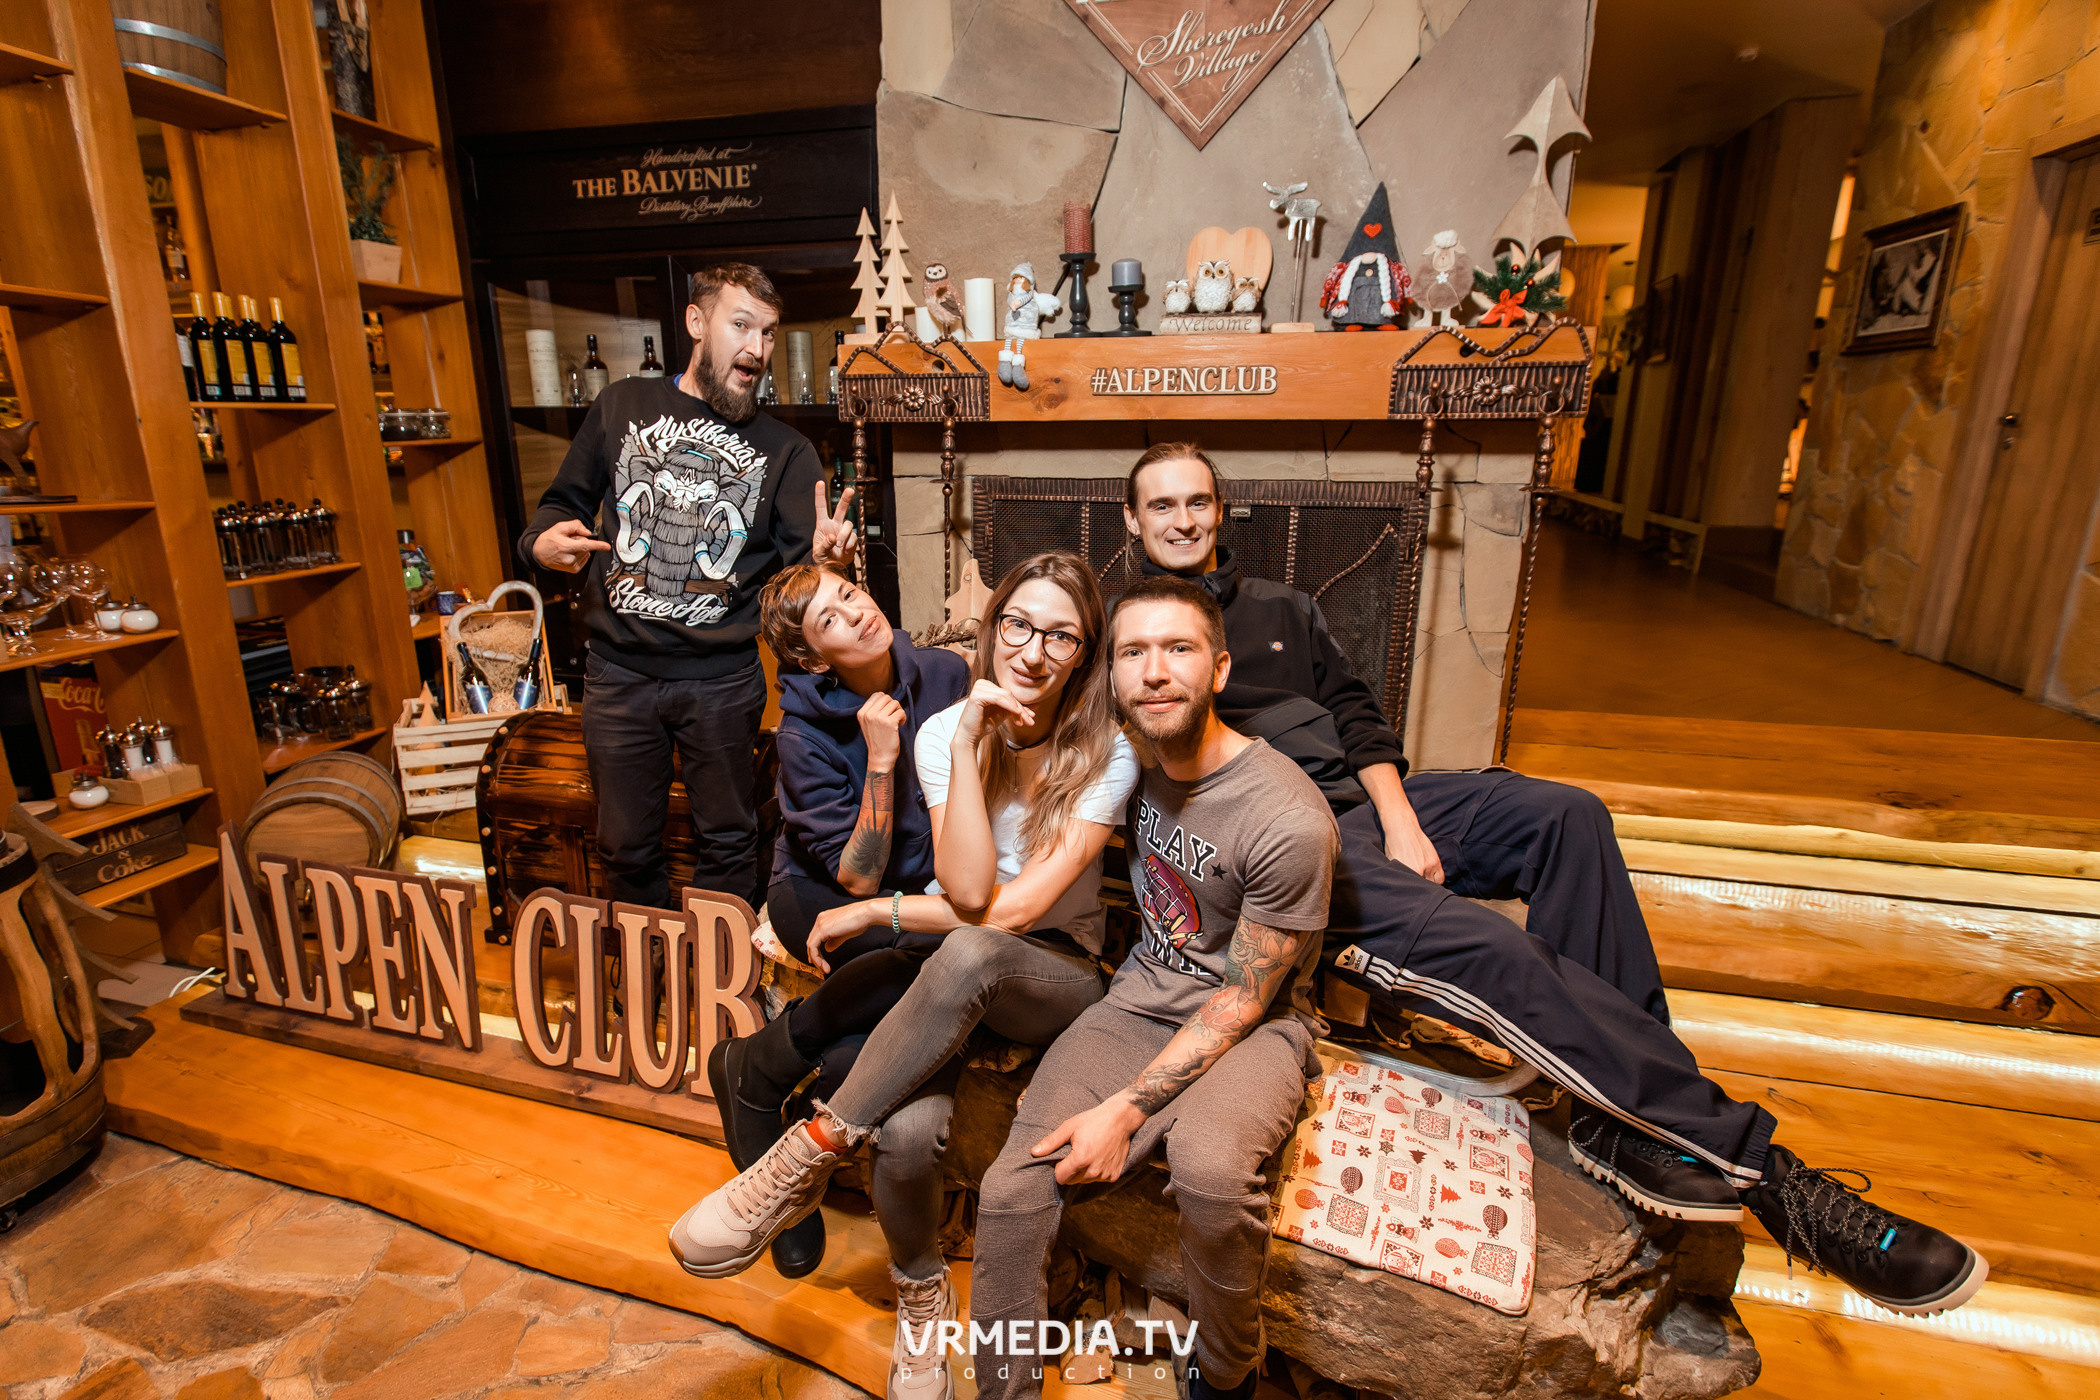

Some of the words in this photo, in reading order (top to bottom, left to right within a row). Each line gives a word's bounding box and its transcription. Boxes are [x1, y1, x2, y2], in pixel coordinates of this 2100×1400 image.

[1136, 0, 1291, 74] Sheregesh
[1172, 48, 1263, 94] Village
[640, 146, 713, 168] Handcrafted
[716, 141, 753, 159] at
[572, 178, 617, 199] THE
[1169, 316, 1253, 332] Welcome
[1091, 366, 1278, 393] #ALPENCLUB
[609, 576, 674, 617] Stone
[672, 593, 729, 627] Age
[118, 849, 131, 860] &
[1134, 796, 1218, 883] PLAY
[219, 829, 475, 1050] ALPEN
[512, 892, 767, 1099] CLUB
